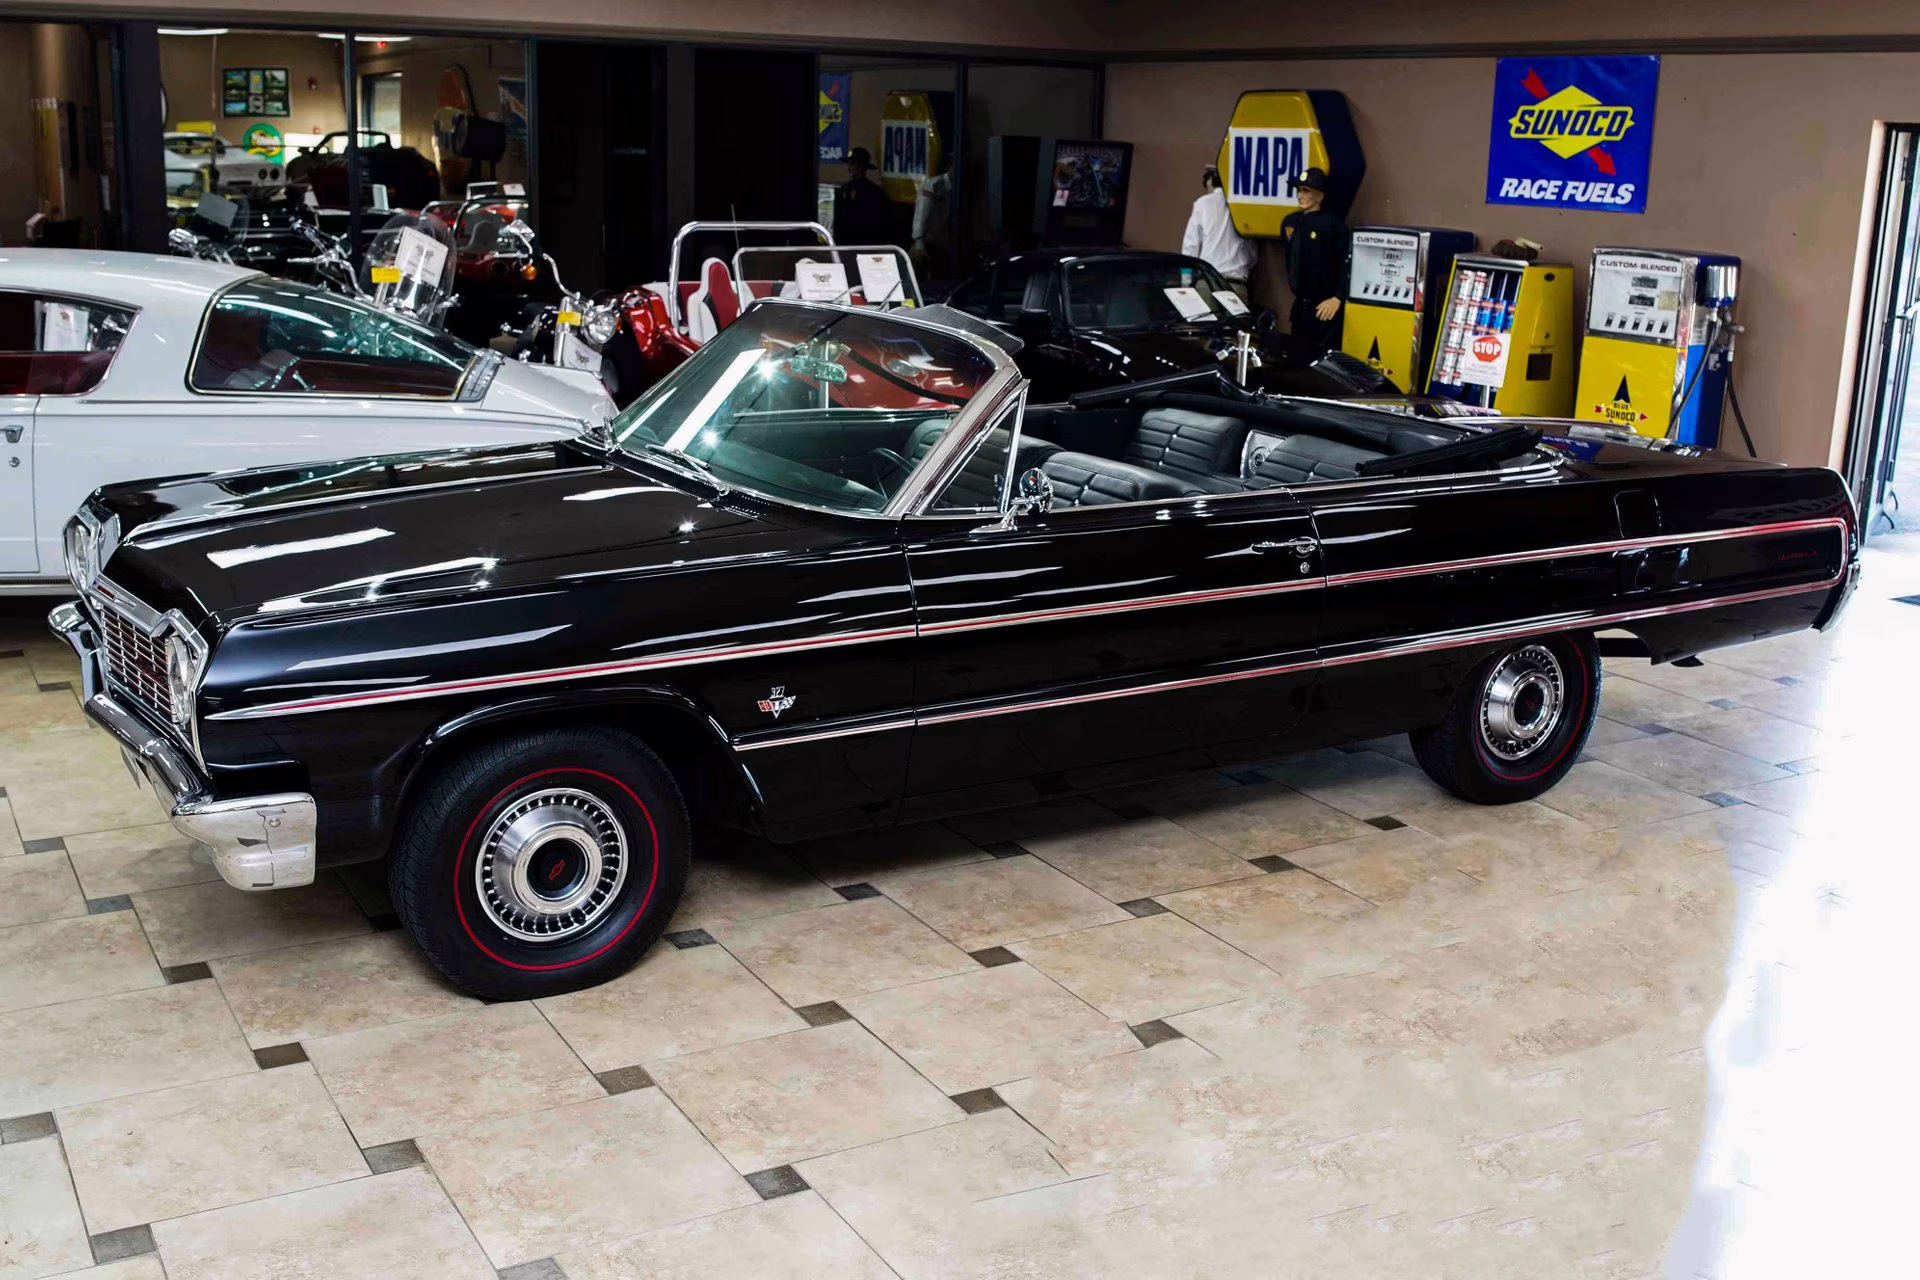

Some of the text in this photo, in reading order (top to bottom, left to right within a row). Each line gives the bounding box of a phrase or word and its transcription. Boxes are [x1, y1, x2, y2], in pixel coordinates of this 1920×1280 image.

[1514, 109, 1629, 137] SUNOCO
[1233, 136, 1303, 198] NAPA
[1499, 177, 1636, 205] RACE FUELS
[1473, 341, 1501, 356] STOP
[1613, 402, 1629, 410] BLUE
[1605, 408, 1636, 422] SUNOCO
[770, 685, 786, 698] 327
